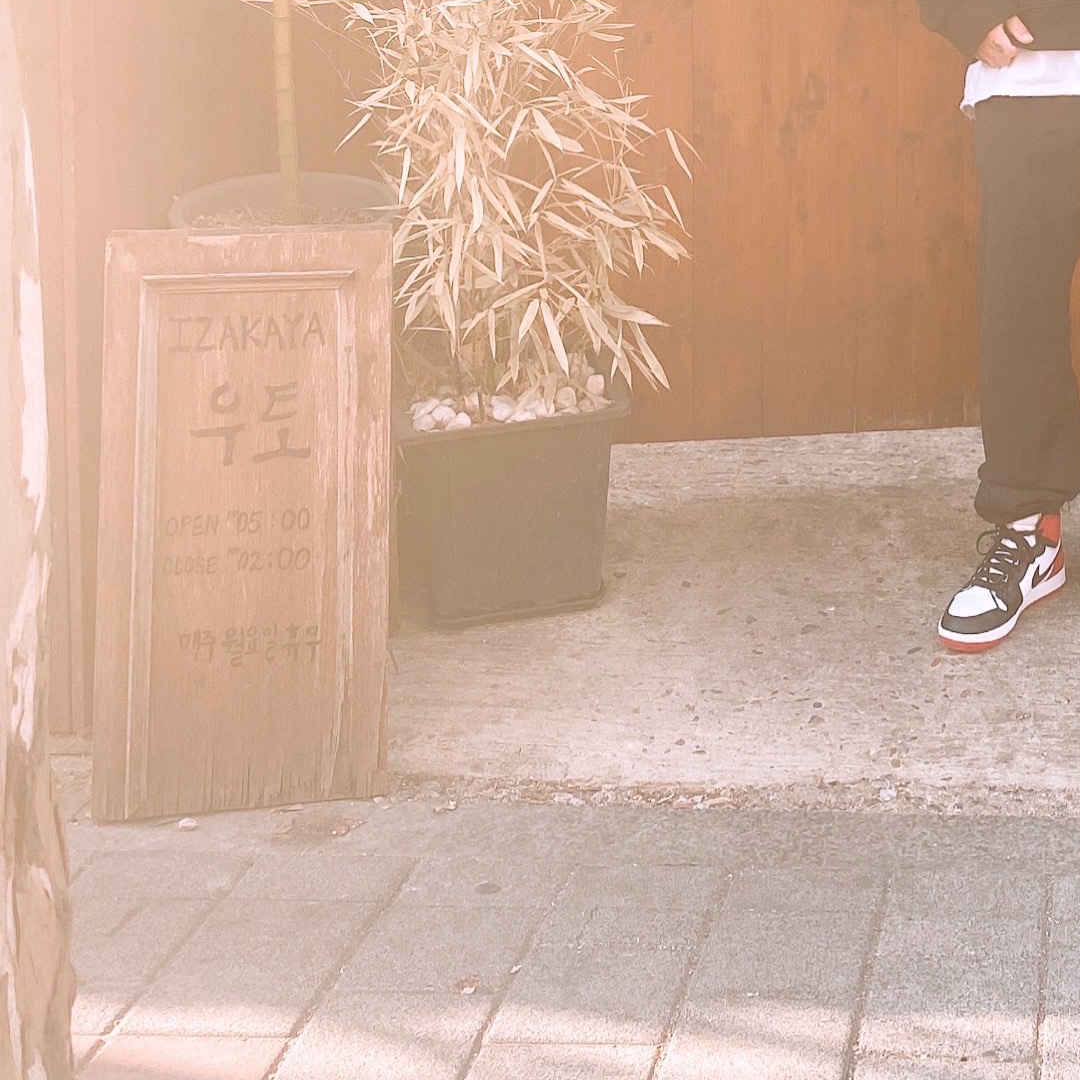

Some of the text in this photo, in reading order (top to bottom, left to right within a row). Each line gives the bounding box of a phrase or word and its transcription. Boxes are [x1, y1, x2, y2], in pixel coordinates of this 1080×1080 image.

[168, 311, 325, 352] IZAKAYA
[189, 380, 311, 466] 우토
[166, 514, 219, 537] OPEN
[162, 554, 217, 576] CLOSE
[179, 623, 324, 668] 매주 월요일 휴무
